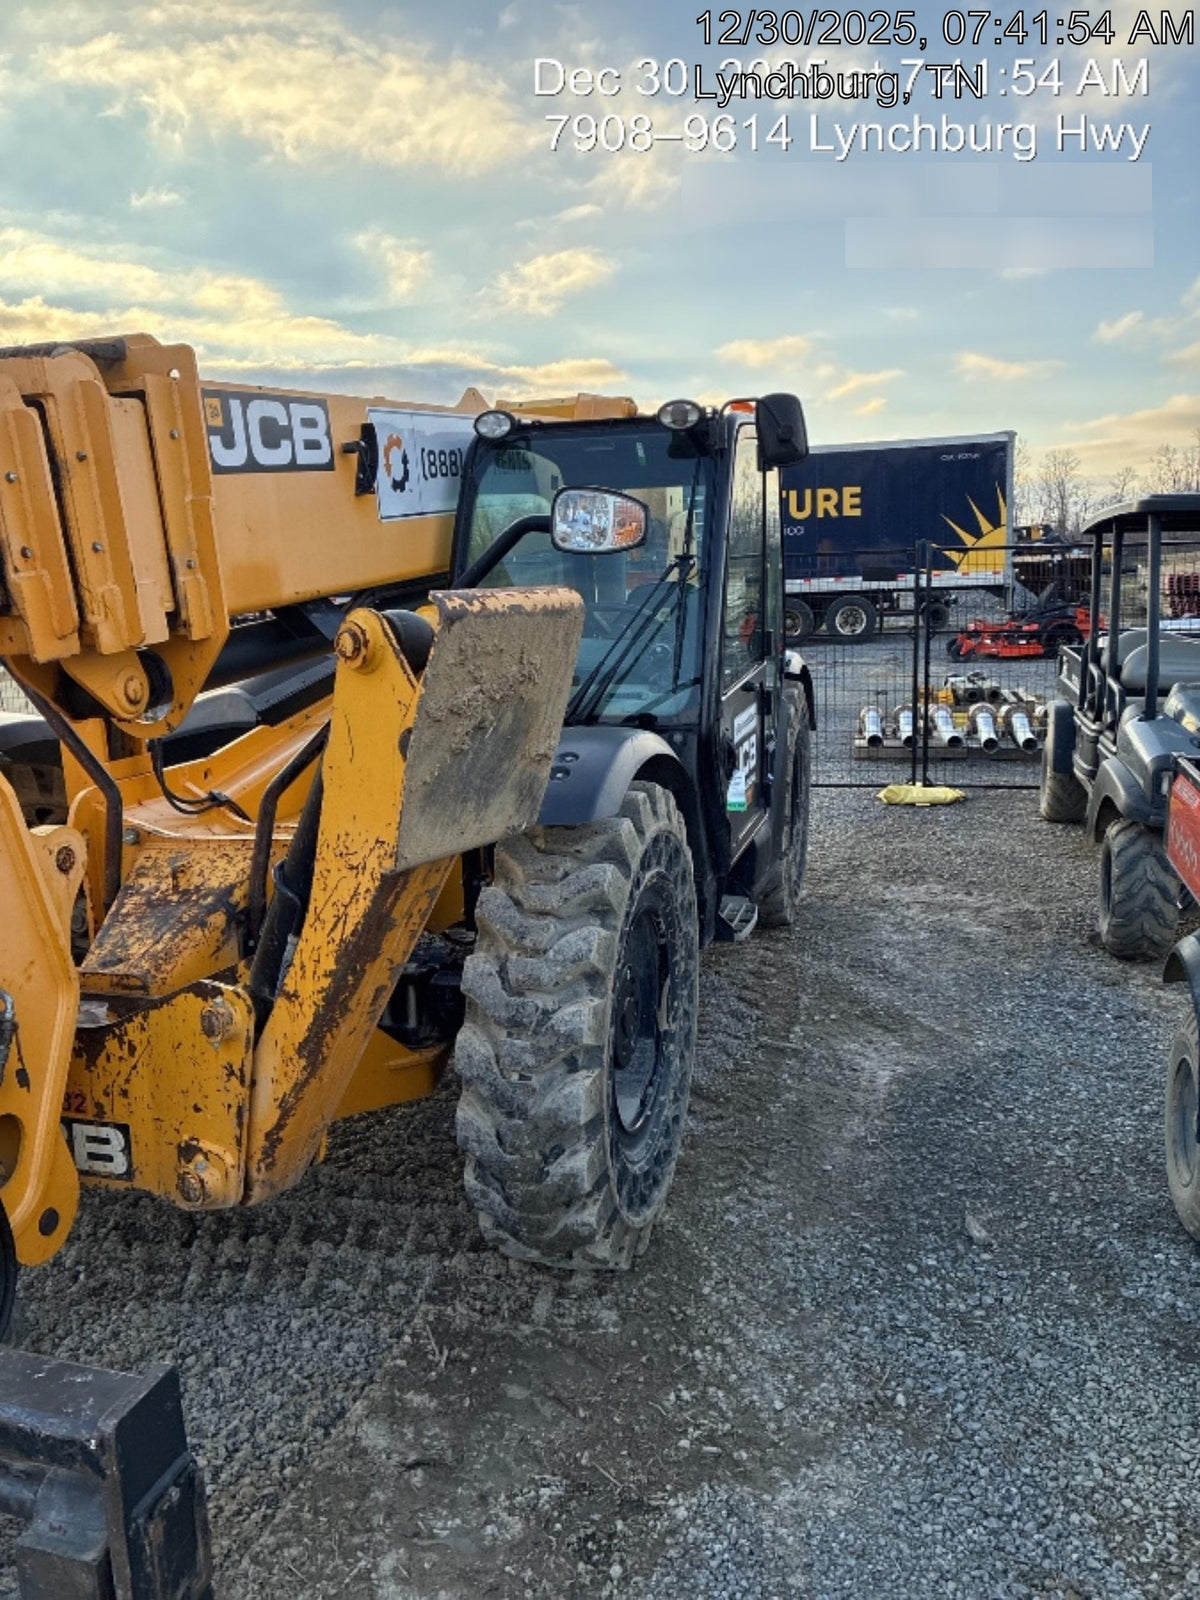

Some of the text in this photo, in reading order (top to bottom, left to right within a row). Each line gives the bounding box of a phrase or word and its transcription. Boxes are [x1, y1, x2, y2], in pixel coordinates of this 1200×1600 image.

[208, 398, 332, 467] JCB
[781, 486, 862, 520] URE
[60, 1122, 127, 1175] B
